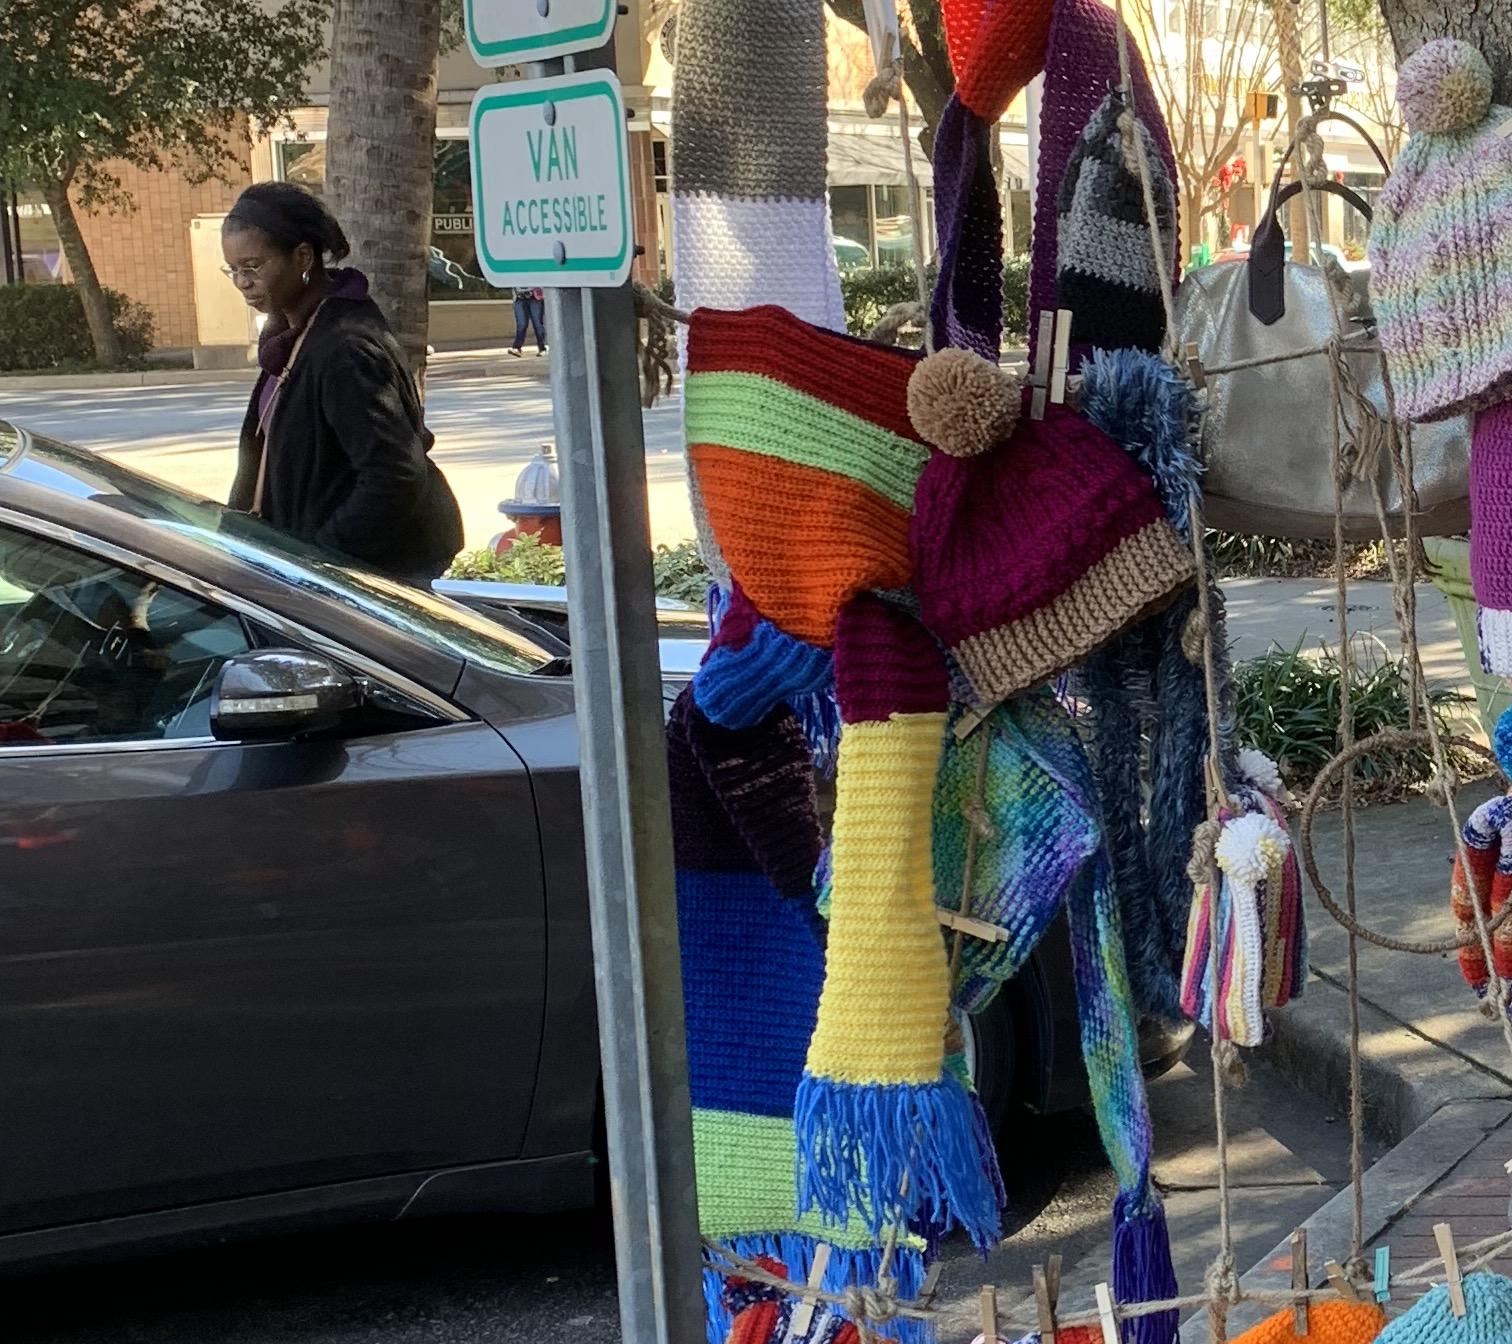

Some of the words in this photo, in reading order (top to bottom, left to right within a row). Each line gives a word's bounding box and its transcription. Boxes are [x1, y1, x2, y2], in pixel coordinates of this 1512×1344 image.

[526, 125, 579, 183] VAN
[434, 217, 473, 230] PUBLI
[502, 193, 608, 236] ACCESSIBLE
